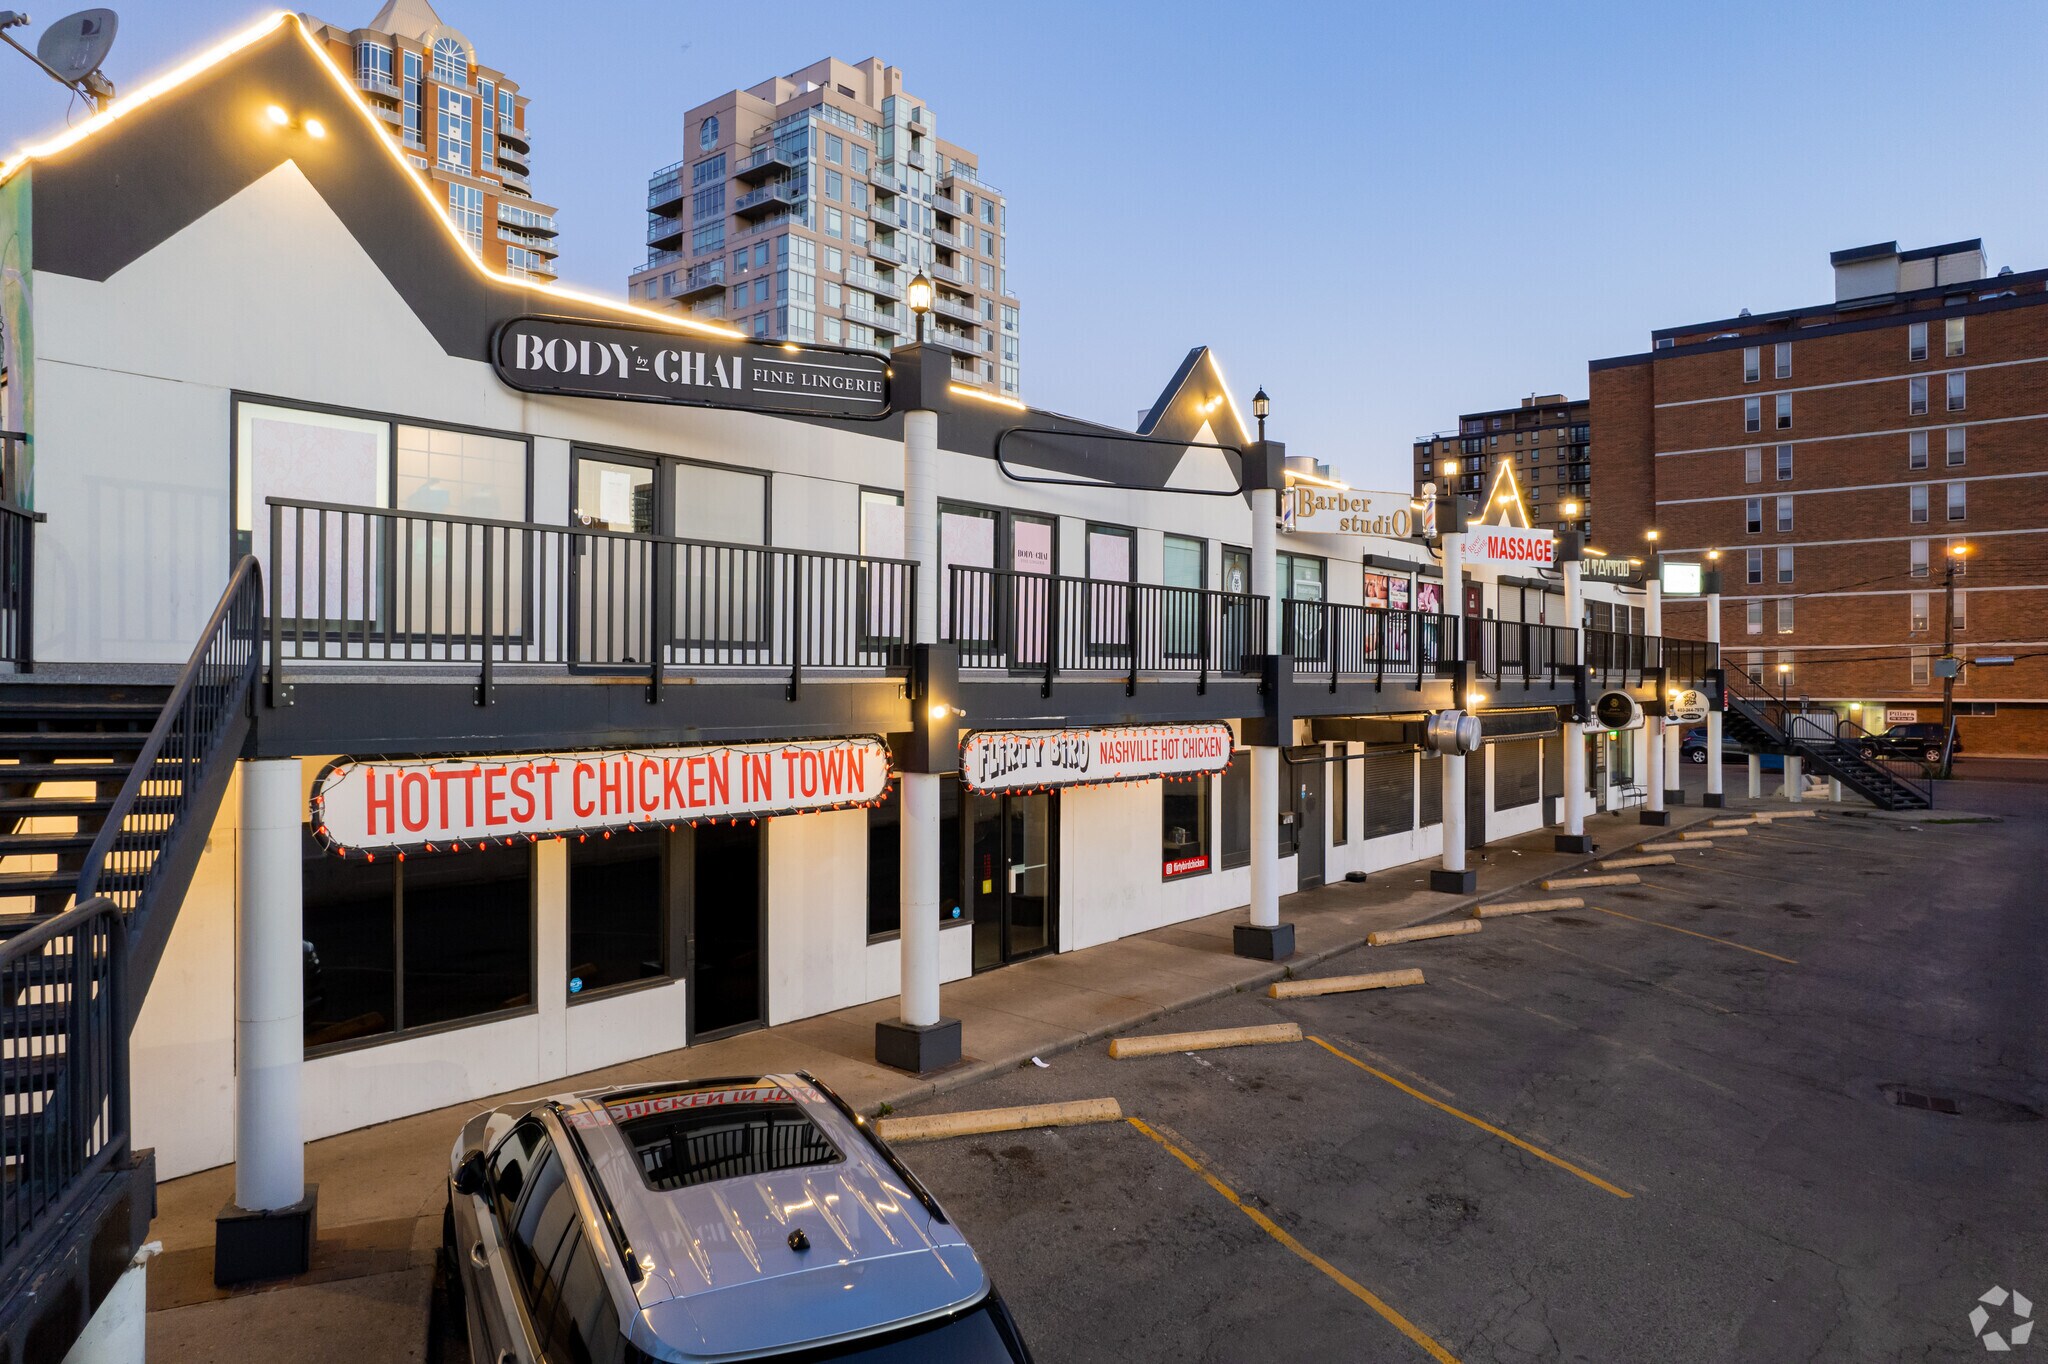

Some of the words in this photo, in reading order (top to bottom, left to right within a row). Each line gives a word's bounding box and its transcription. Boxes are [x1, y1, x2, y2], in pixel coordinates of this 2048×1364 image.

[515, 333, 638, 378] BODY
[636, 355, 649, 367] by
[653, 349, 743, 390] CHAI
[752, 368, 795, 385] FINE
[801, 373, 883, 394] LINGERIE
[1296, 487, 1372, 518] Barber
[1487, 535, 1552, 562] MASSAGE
[1100, 740, 1159, 764] NASHVILLE
[1161, 739, 1180, 760] HOT
[1182, 736, 1222, 758] CHICKEN
[366, 765, 560, 836] HOTTEST
[572, 753, 730, 818] CHICKEN
[741, 753, 772, 803] IN
[784, 748, 865, 798] TOWN
